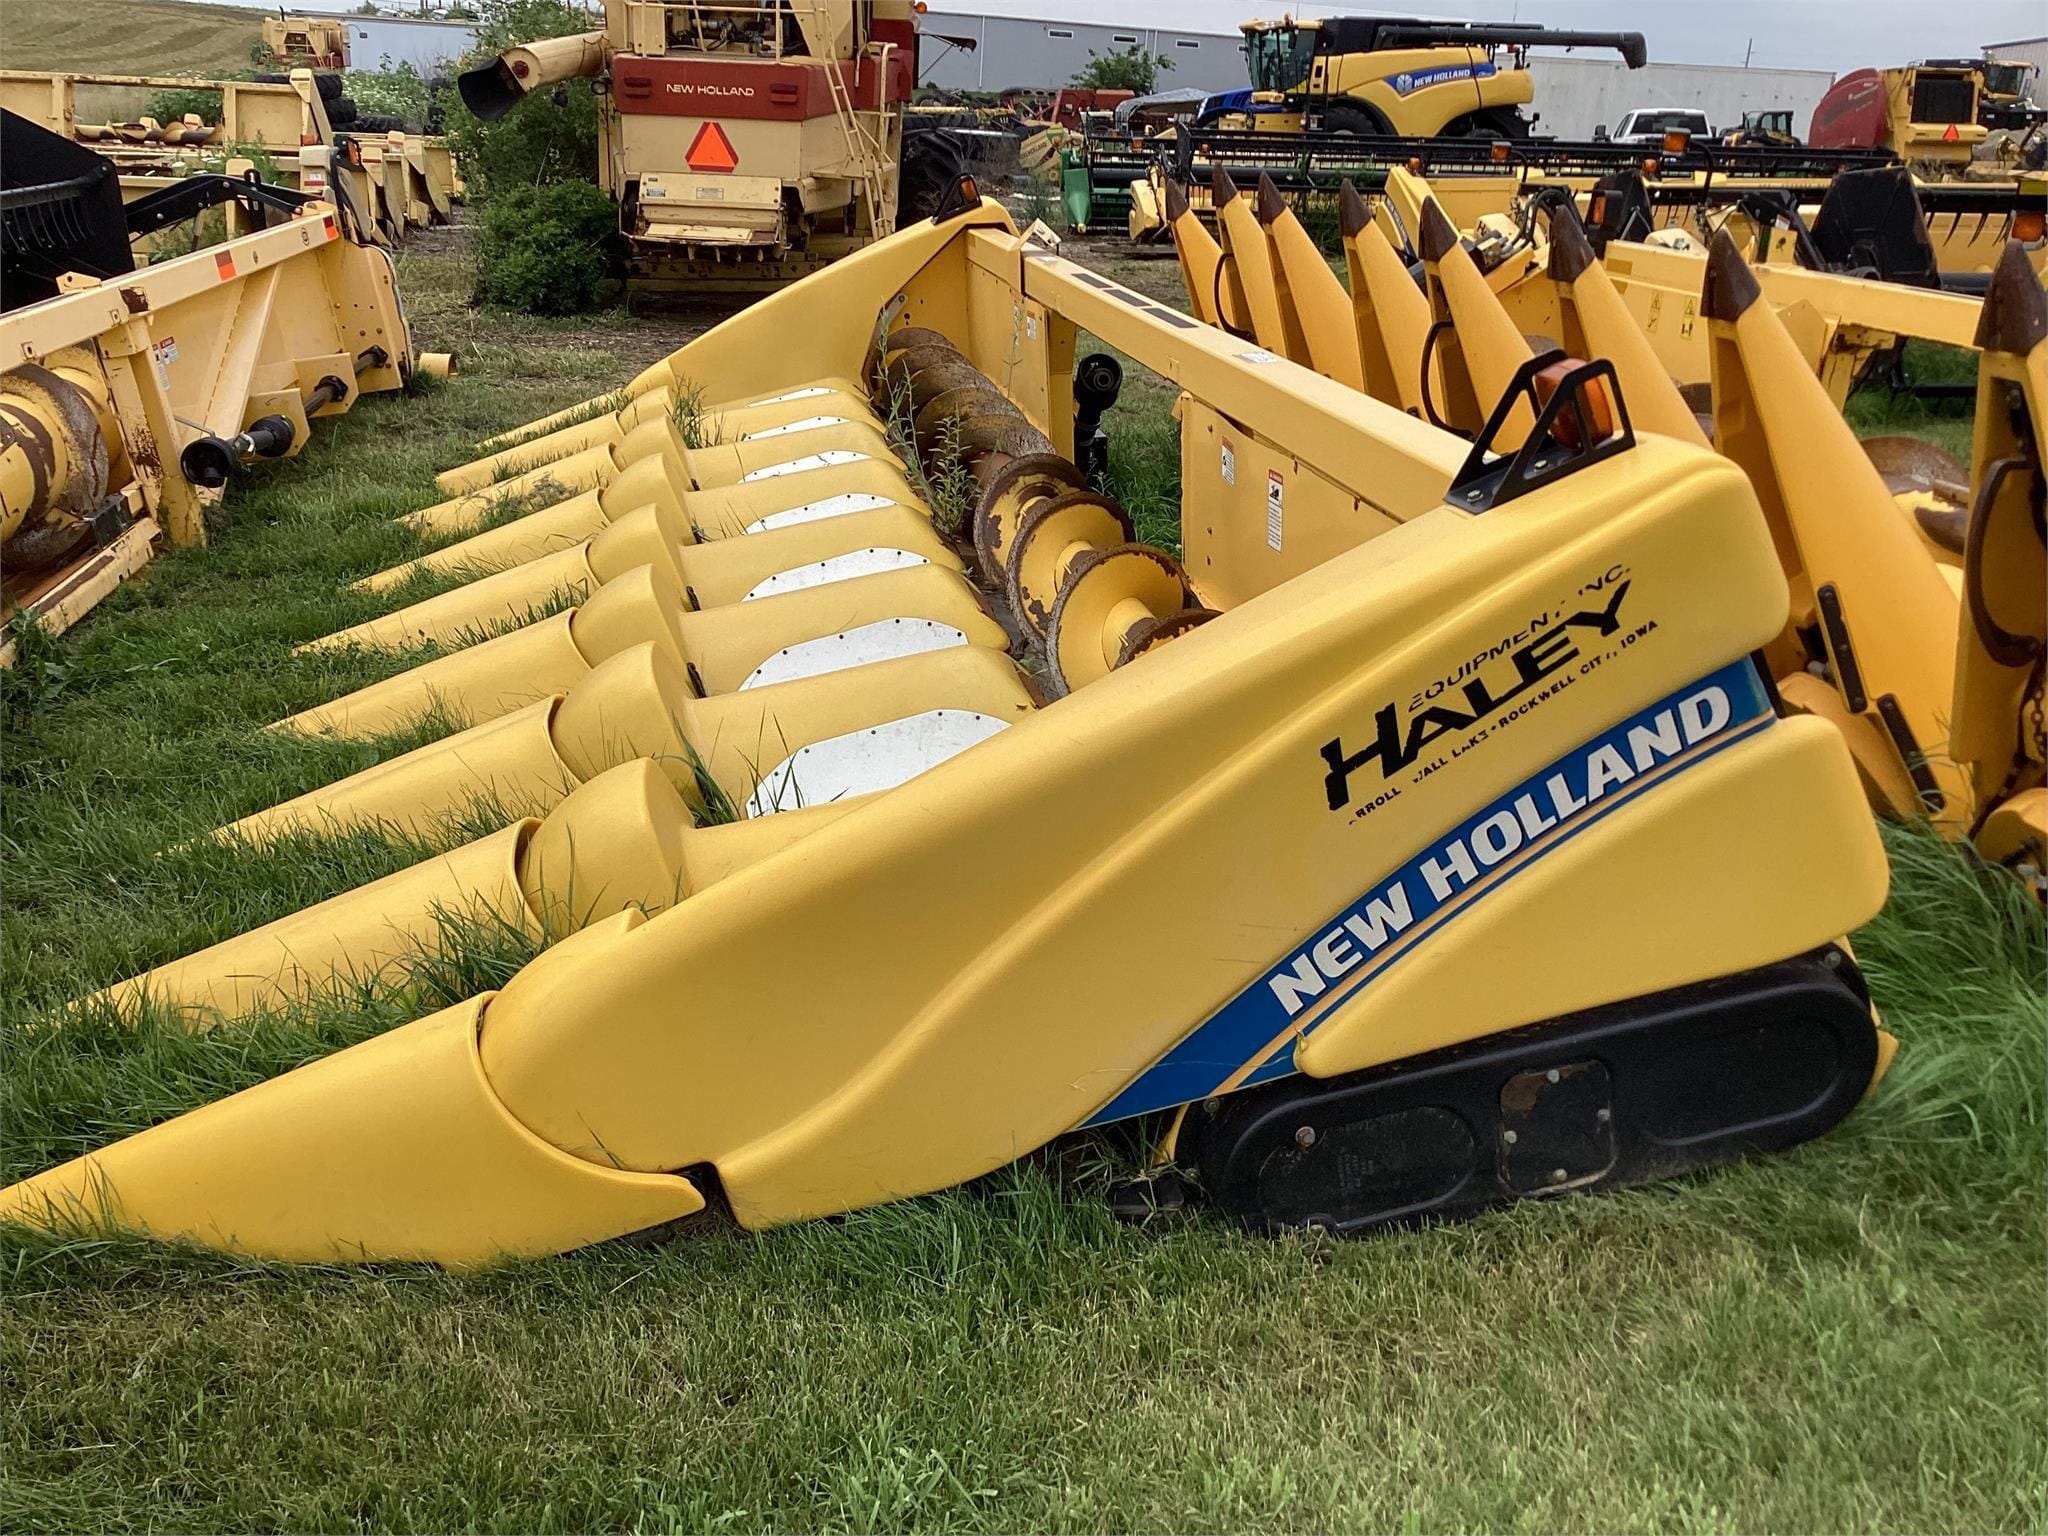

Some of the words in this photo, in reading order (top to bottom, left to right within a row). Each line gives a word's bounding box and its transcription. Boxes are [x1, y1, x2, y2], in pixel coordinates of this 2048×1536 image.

[666, 83, 694, 94] NEW
[697, 85, 755, 97] HOLLAND
[1414, 75, 1432, 88] NEW
[1433, 69, 1470, 82] HOLLAND
[1577, 563, 1631, 596] NC.
[1319, 579, 1632, 811] HALEY
[1498, 675, 1576, 728] ROCKWELL
[1579, 651, 1618, 675] CIT,
[1620, 620, 1659, 649] IOWA
[1267, 881, 1416, 1016] NEW
[1419, 684, 1731, 902] HOLLAND
